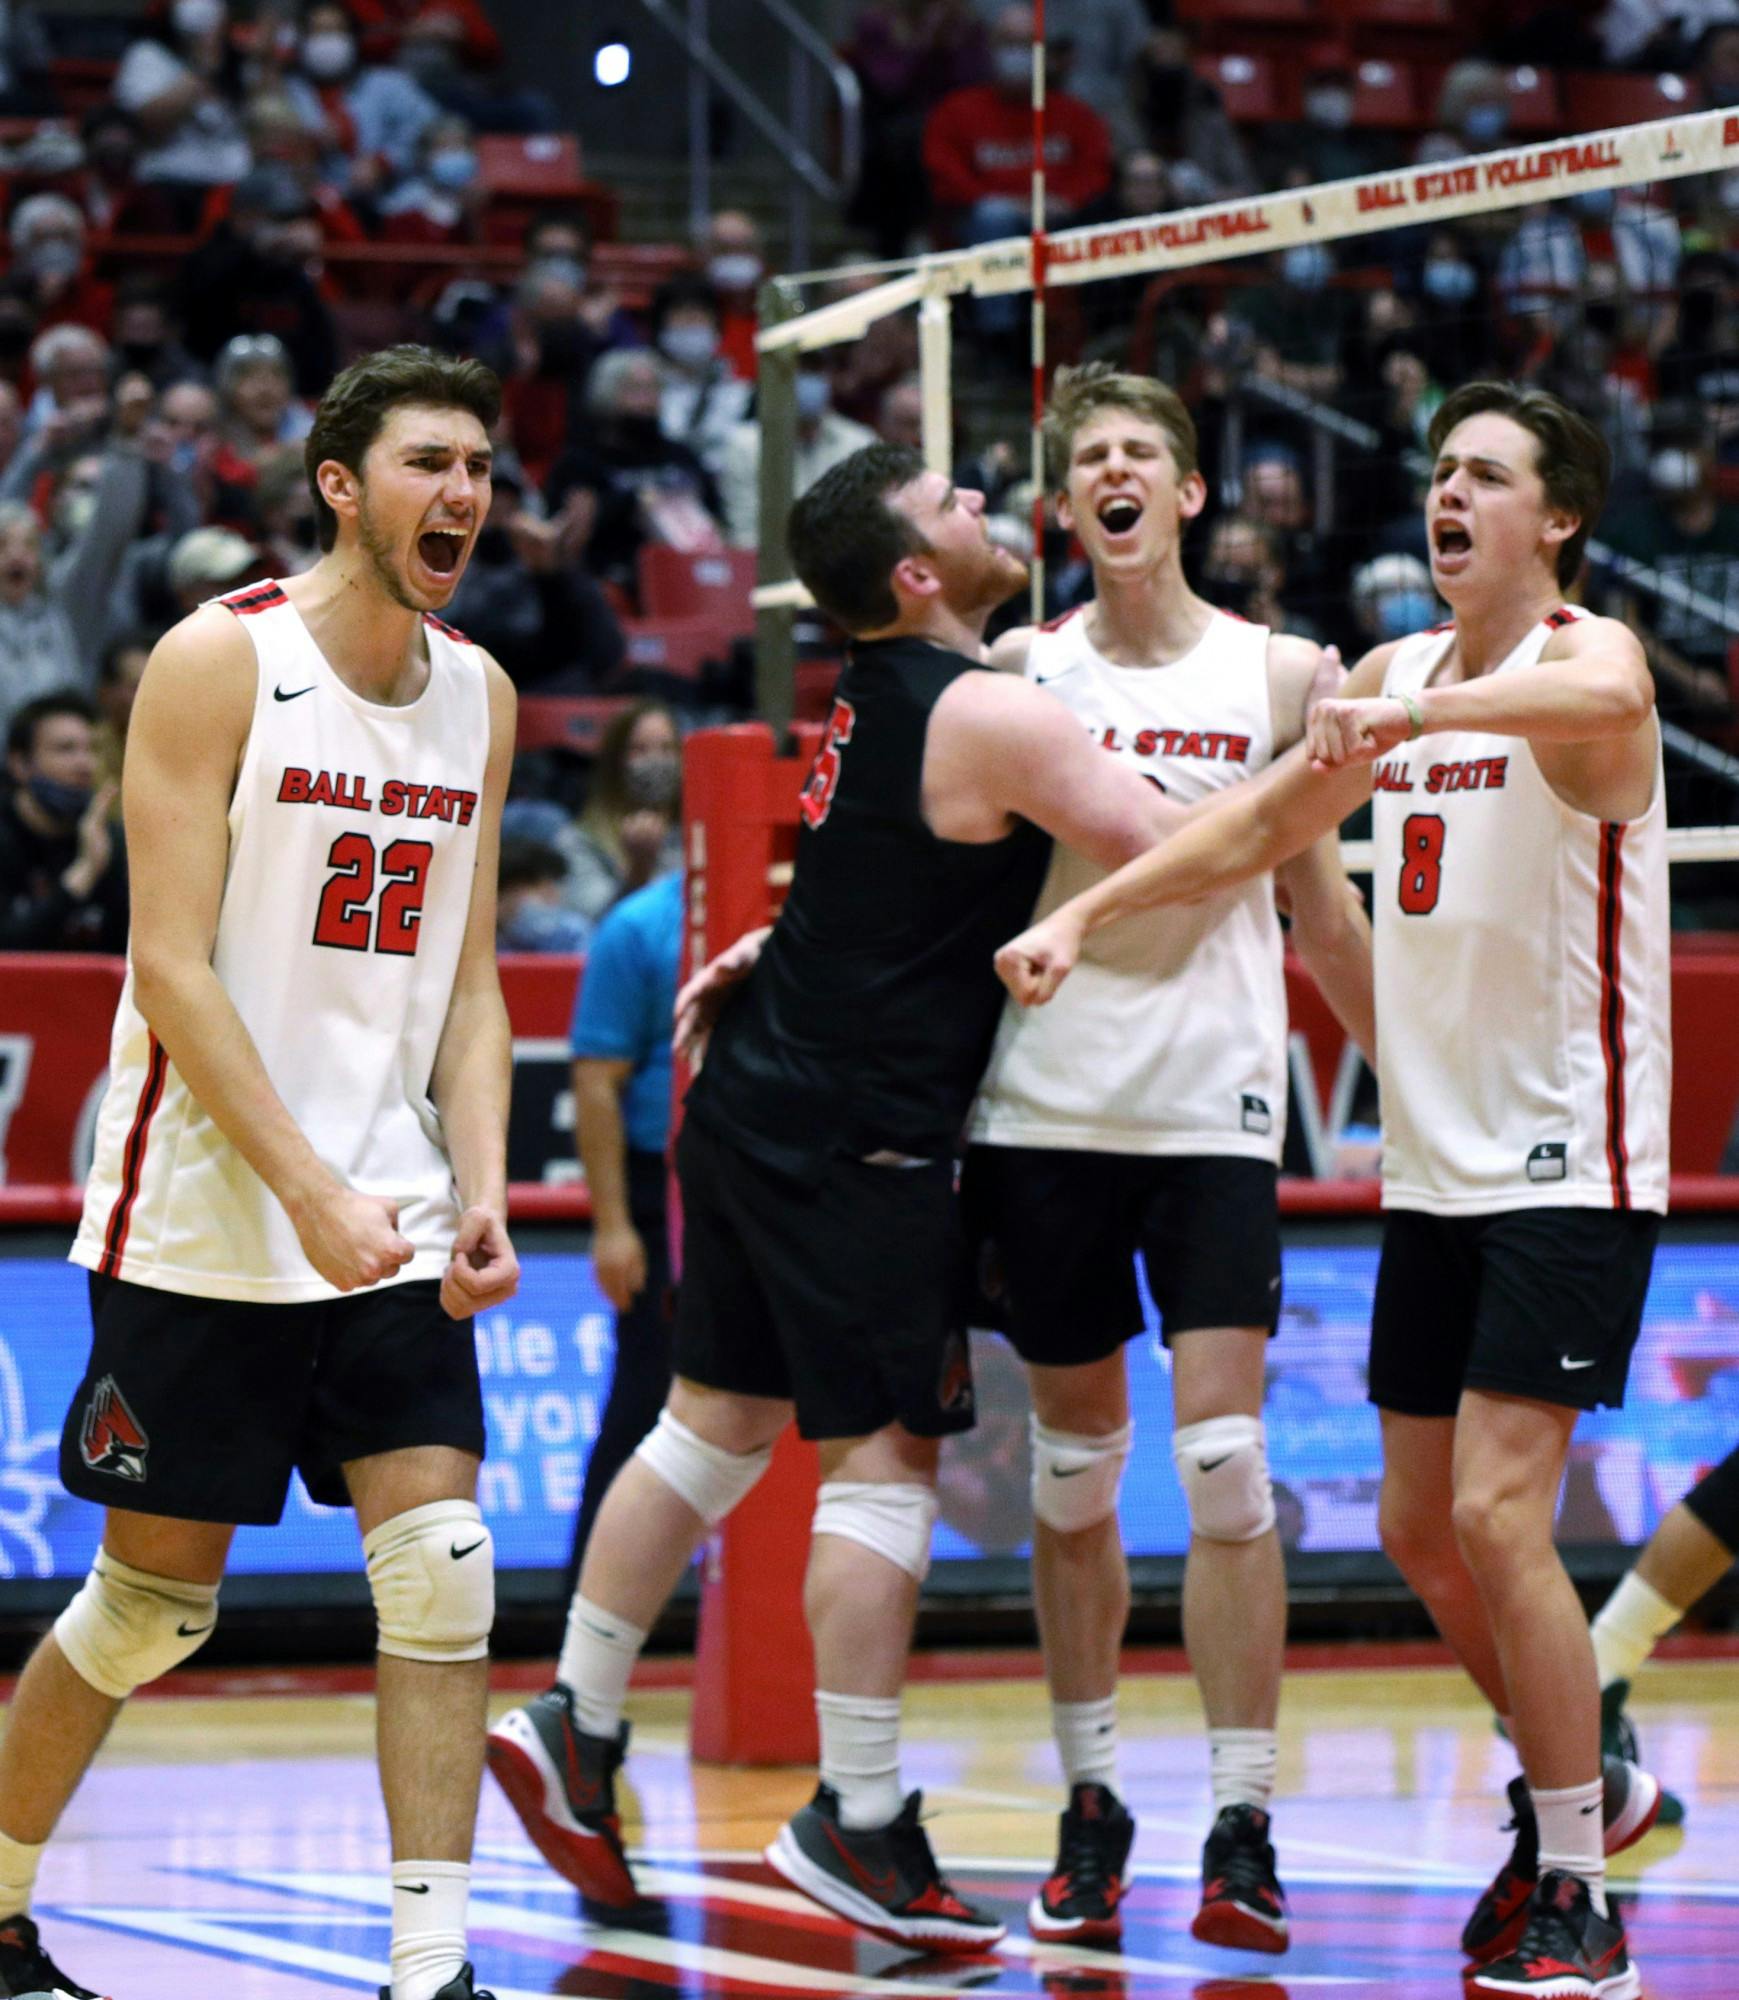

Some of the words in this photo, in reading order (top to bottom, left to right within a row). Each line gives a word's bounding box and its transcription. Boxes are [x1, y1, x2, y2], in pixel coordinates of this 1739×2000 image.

[1724, 116, 1739, 146] B
[1357, 184, 1407, 213] BALL
[1414, 166, 1478, 203] STATE
[1485, 139, 1622, 189] VOLLEYBALL
[1047, 237, 1083, 264] ALL
[1088, 228, 1144, 262] STATE
[1148, 207, 1270, 249] VOLLEYBALL
[1133, 728, 1251, 764] STATE
[1375, 761, 1413, 792] ALL
[1425, 756, 1509, 794] STATE
[277, 767, 372, 811] BALL
[380, 779, 478, 826] STATE
[1399, 813, 1445, 915] 8
[312, 831, 434, 957] 22
